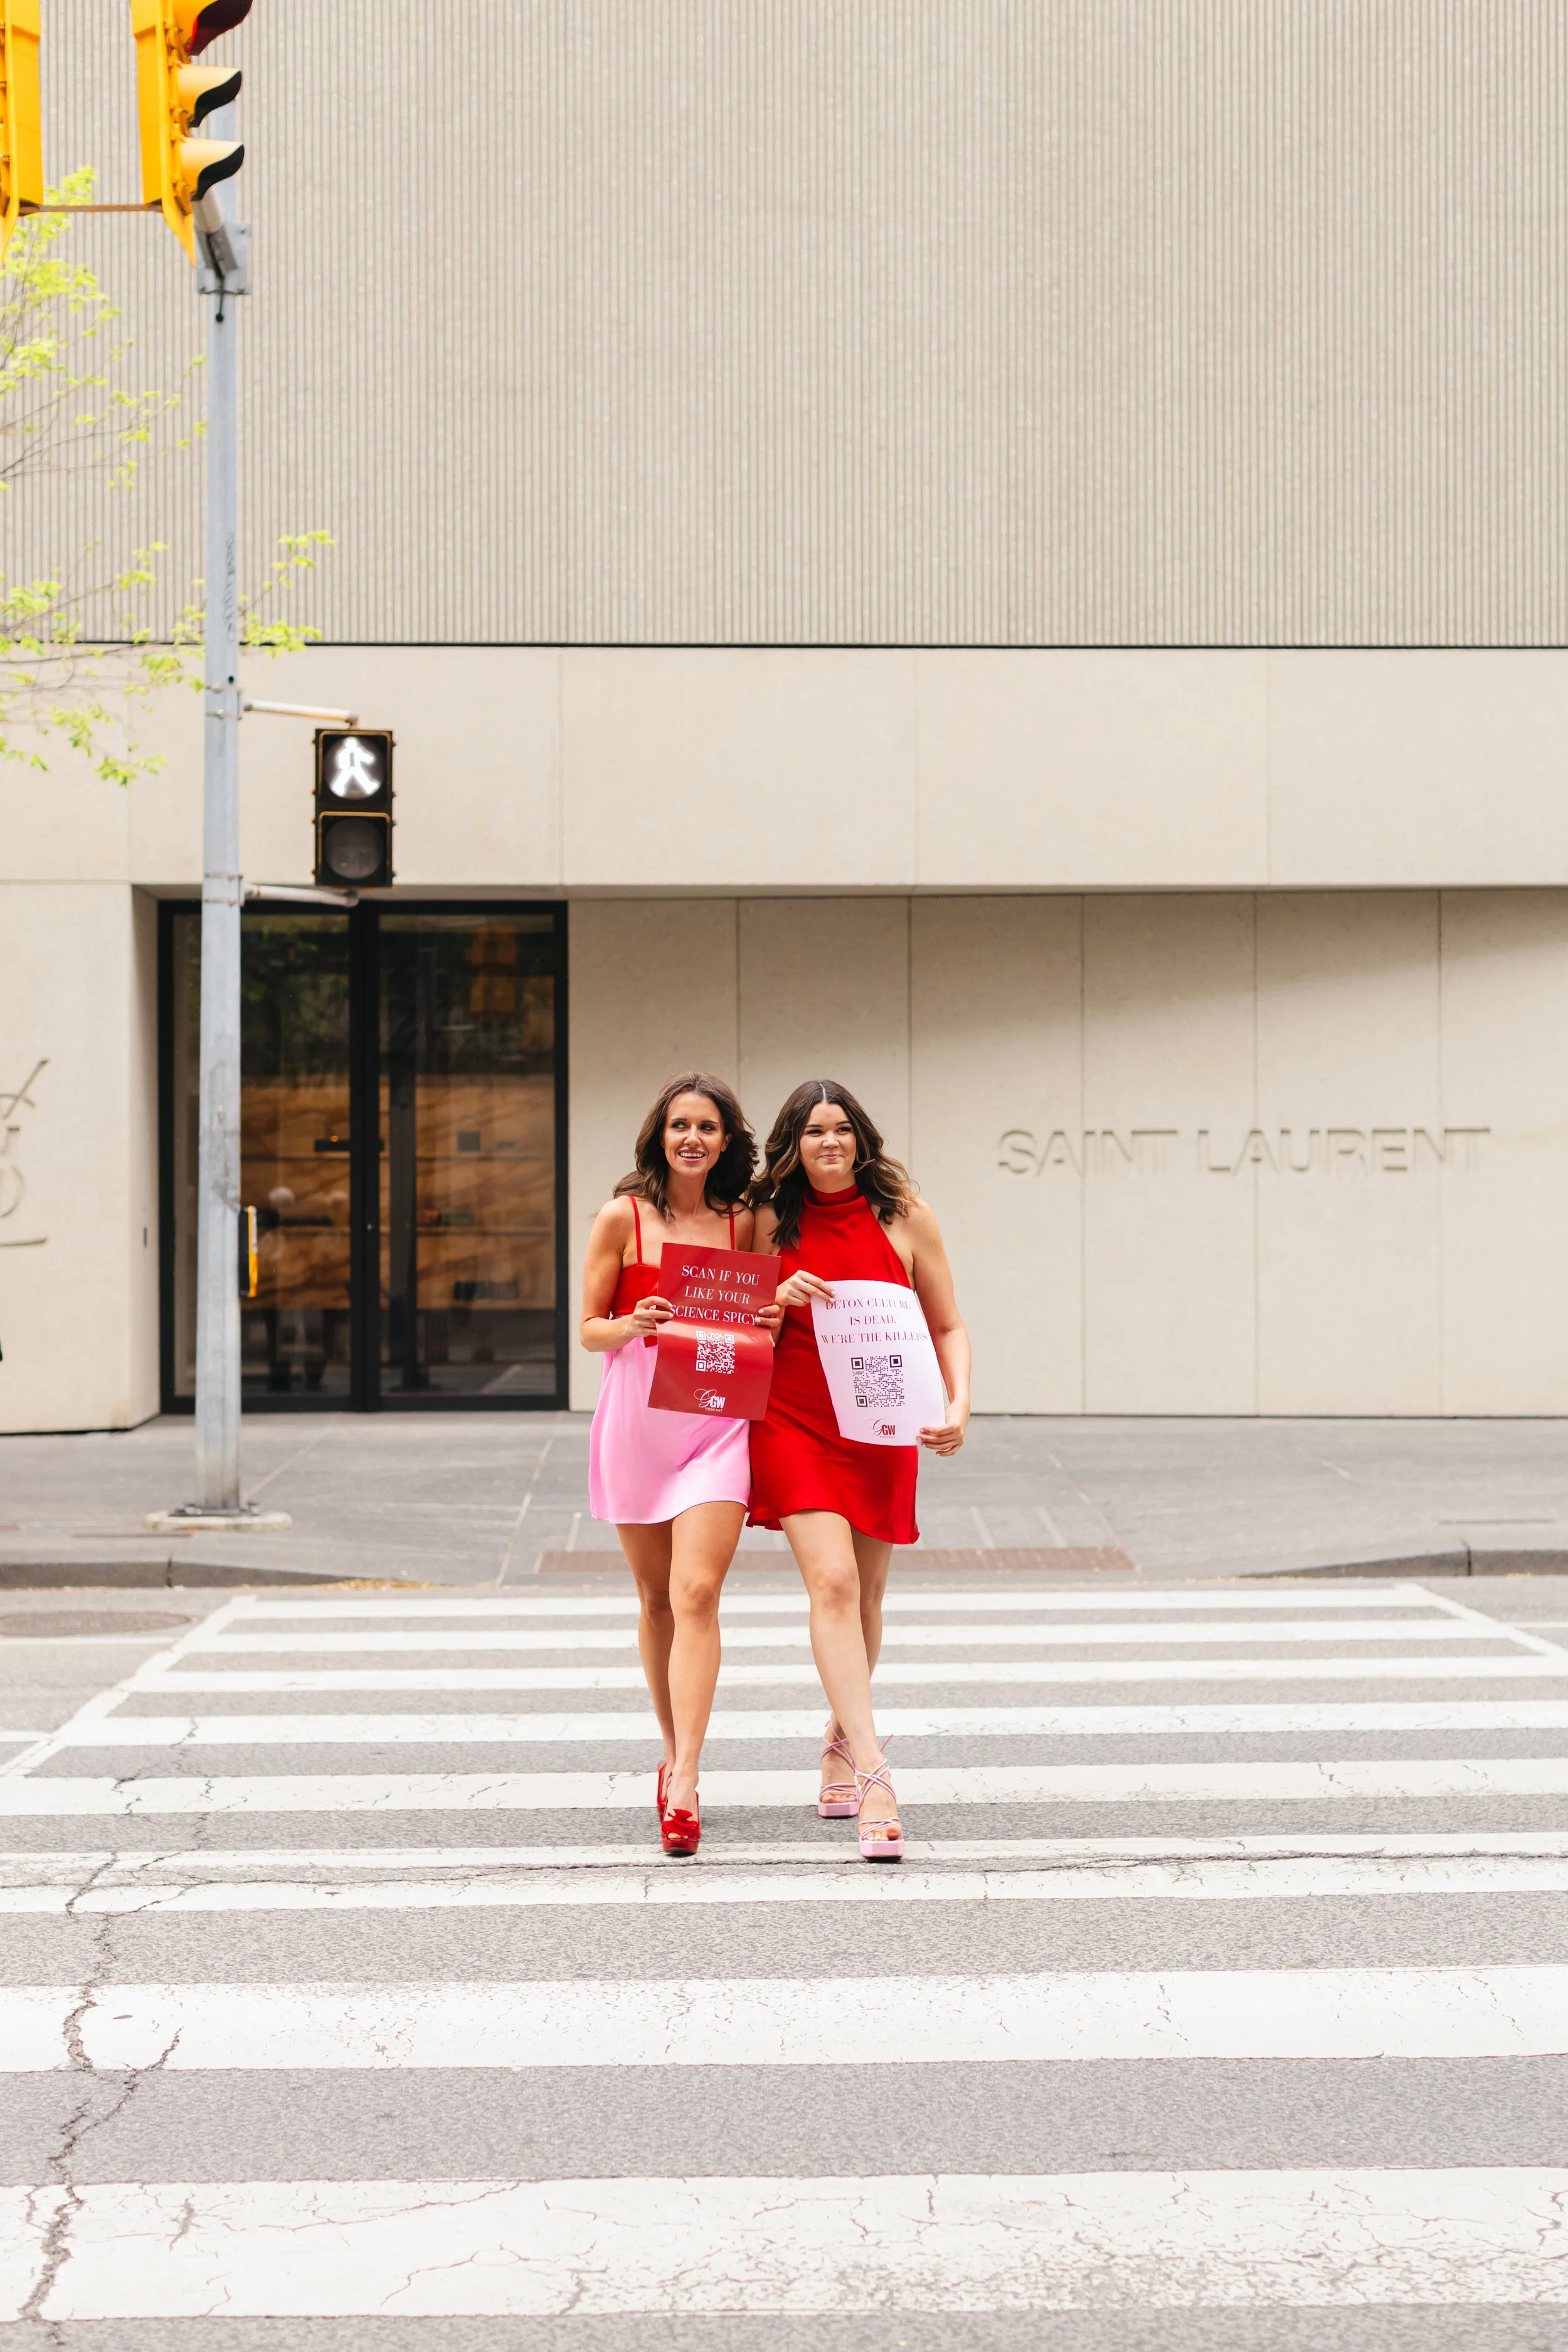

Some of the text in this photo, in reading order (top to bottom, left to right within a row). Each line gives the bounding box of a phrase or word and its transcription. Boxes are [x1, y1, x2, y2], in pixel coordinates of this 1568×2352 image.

[998, 1127, 1491, 1178] SAINT LAURENT
[681, 1265, 760, 1286] SCAN IF YOU
[684, 1286, 750, 1305] LIKE YOUR
[825, 1298, 864, 1310] DETOX
[670, 1305, 720, 1321] SCIENCE
[850, 1314, 896, 1326] IS DEAD.
[821, 1333, 855, 1344] WE'RE
[858, 1332, 882, 1342] THE
